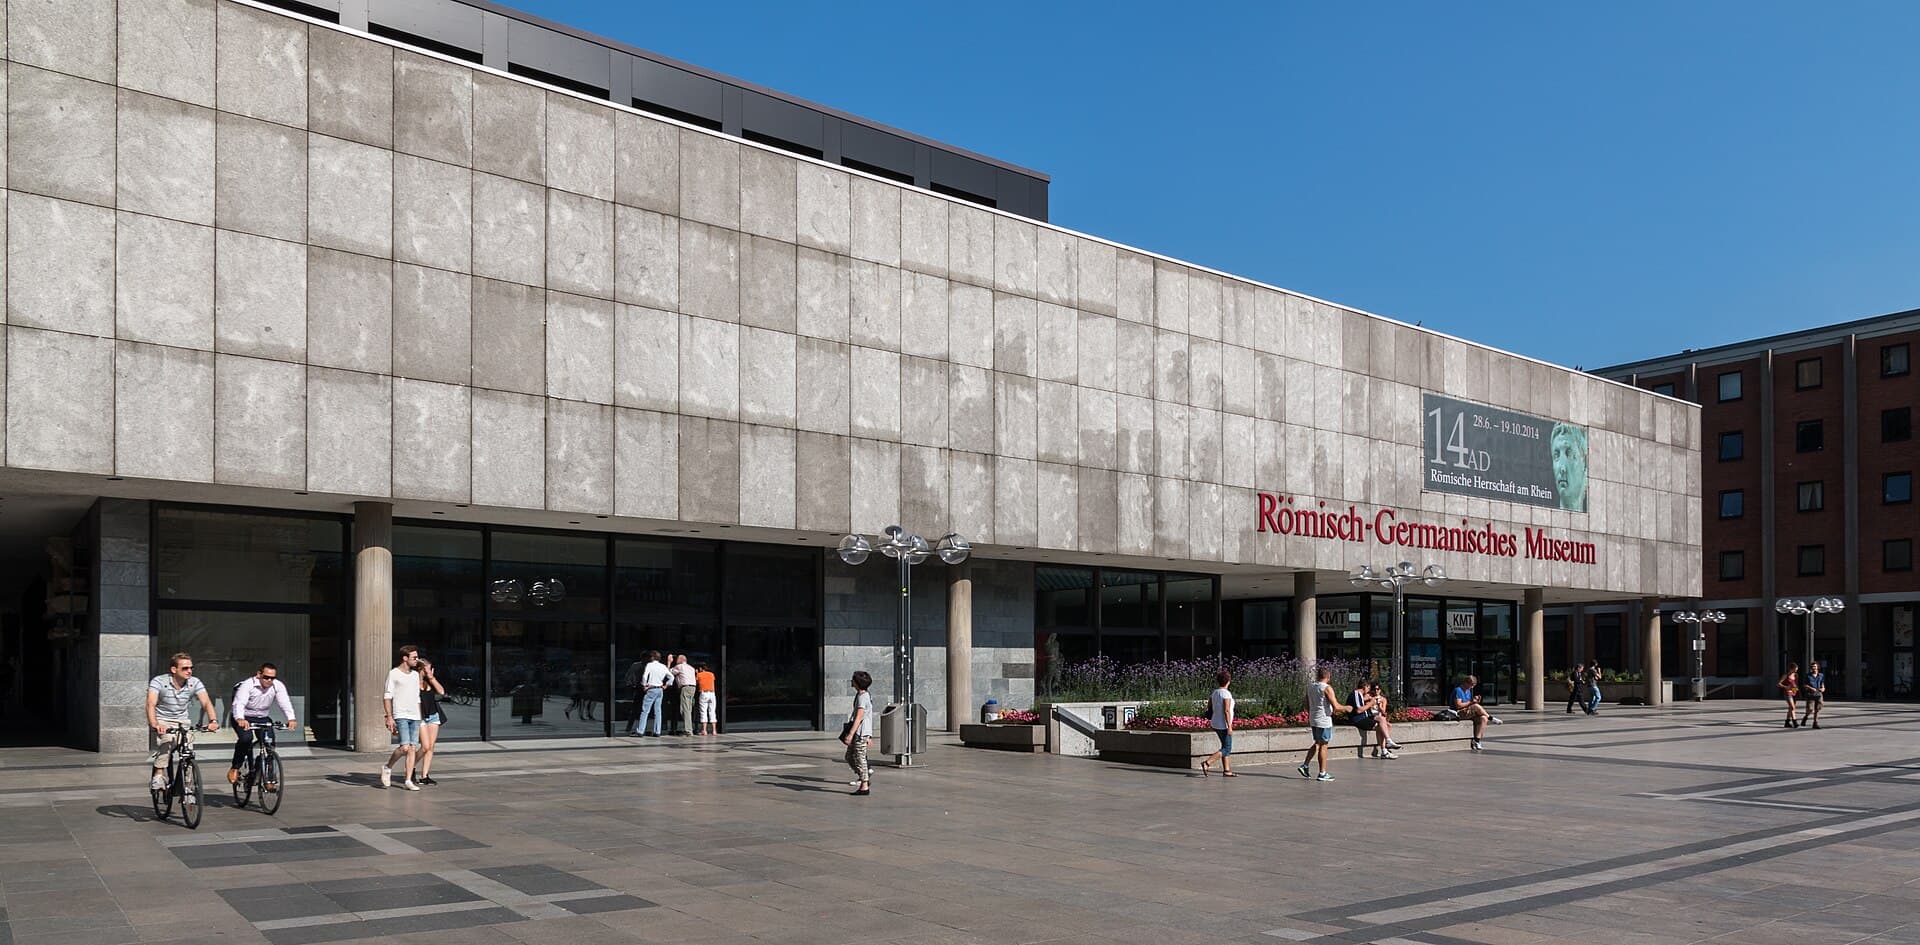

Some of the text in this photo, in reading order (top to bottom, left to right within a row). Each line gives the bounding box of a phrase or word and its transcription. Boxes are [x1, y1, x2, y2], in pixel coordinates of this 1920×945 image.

[1428, 407, 1491, 472] 14 AD
[1473, 414, 1492, 430] 28.6.
[1501, 420, 1540, 440] 19.10.2014
[1430, 468, 1553, 500] Römische Herrschaft am Rhein
[1257, 491, 1597, 565] Römisch-Germanisches Museum
[1316, 610, 1347, 625] KMT
[1453, 613, 1474, 627] KMT
[1107, 713, 1114, 723] P
